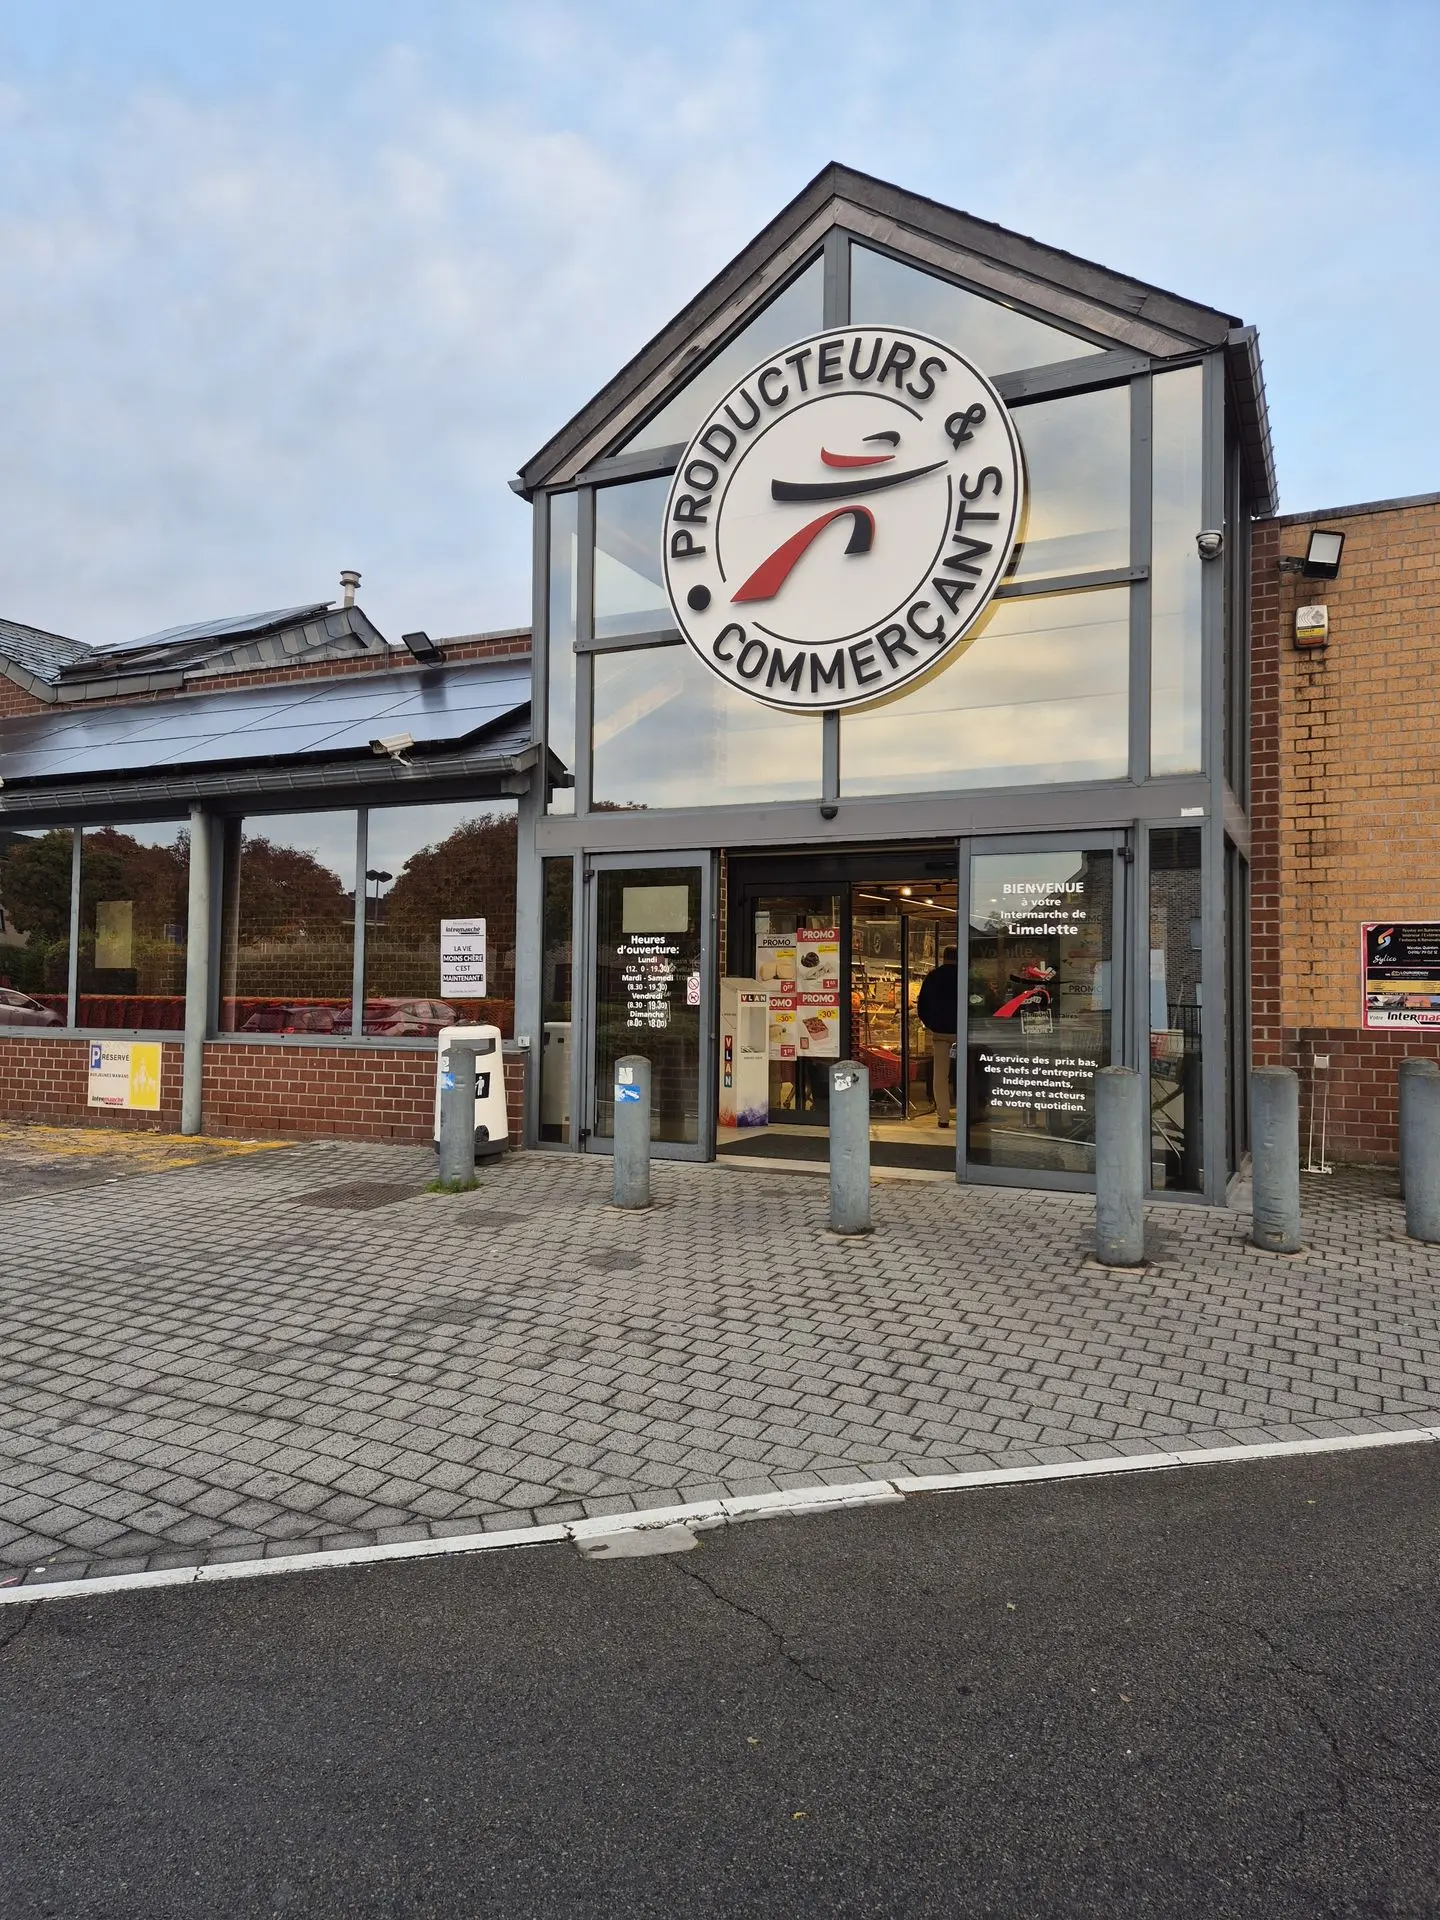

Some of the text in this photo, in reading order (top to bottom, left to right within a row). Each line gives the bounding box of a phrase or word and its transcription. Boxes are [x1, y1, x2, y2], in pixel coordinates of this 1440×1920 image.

[671, 337, 1003, 694] PRODUCTEURS & COMMERÇANTS
[1003, 882, 1084, 894] BIENVENUE
[1031, 898, 1062, 906] votre
[1072, 909, 1087, 918] de
[1008, 923, 1079, 935] Limelette
[802, 930, 835, 939] PROMO
[631, 936, 666, 944] Heures
[617, 945, 680, 954] d'ouverture:
[1372, 954, 1397, 965] Sylico
[650, 964, 670, 973] 19.30)
[648, 982, 668, 991] 19.30)
[802, 994, 835, 1002] PROMO
[627, 1001, 643, 1009] (8.30
[648, 1000, 667, 1010] 19.30)
[627, 1018, 643, 1027] (8.00
[648, 1019, 667, 1028] 18.00)
[980, 1054, 1099, 1068] Au service des prix bas,
[984, 1065, 1094, 1078] des chefs d'entreprise
[1003, 1077, 1074, 1089] Indépendants,
[992, 1088, 1033, 1098] citoyens
[1048, 1092, 1086, 1100] acteurs
[990, 1098, 1087, 1112] de votre quotidien.
